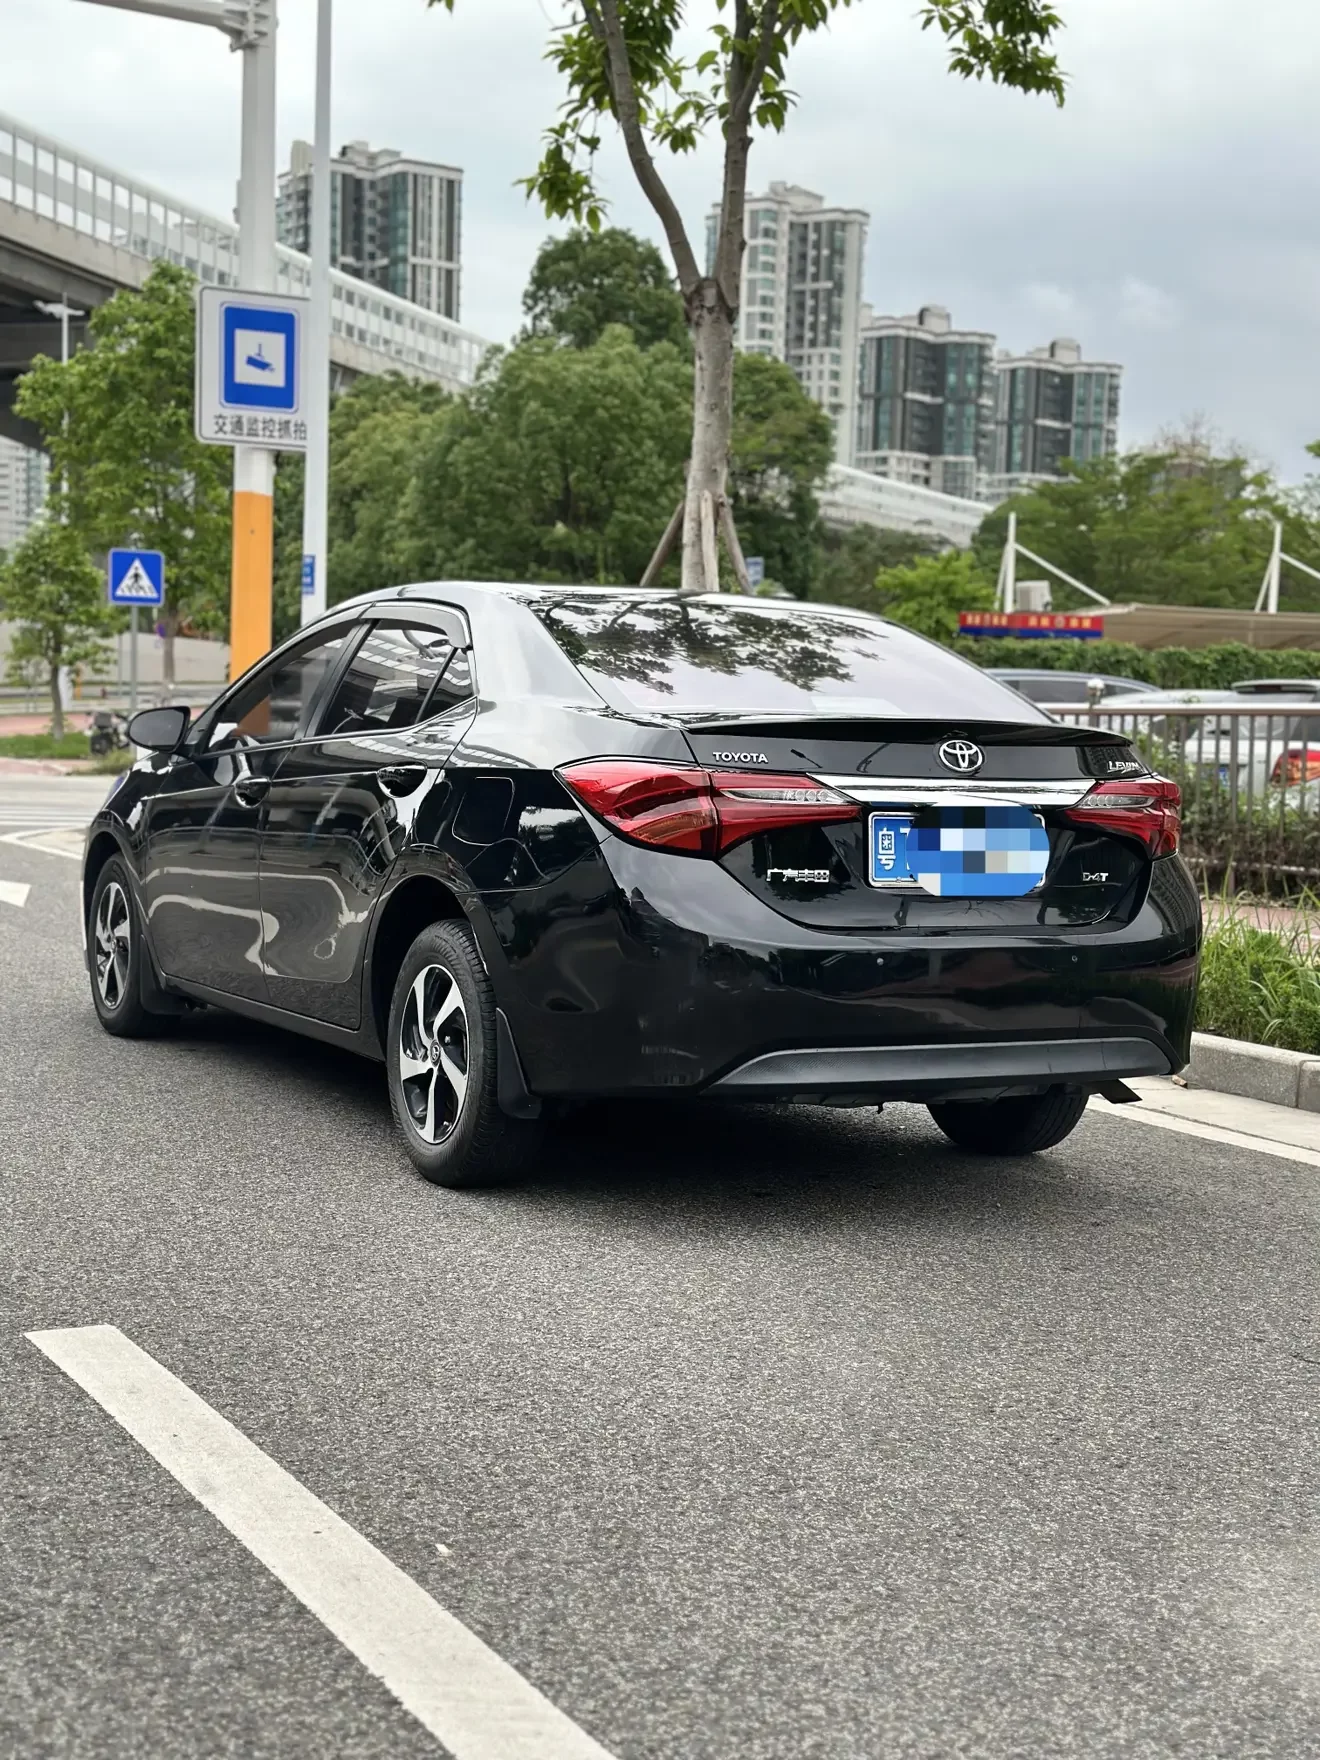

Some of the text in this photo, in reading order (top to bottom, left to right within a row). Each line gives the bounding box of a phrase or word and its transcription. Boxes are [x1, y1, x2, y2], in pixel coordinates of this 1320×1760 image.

[213, 413, 307, 441] 交通监控抓拍
[712, 751, 768, 763] TOYOTA
[1107, 760, 1141, 774] LEVIN
[766, 868, 830, 883] 广汽丰田
